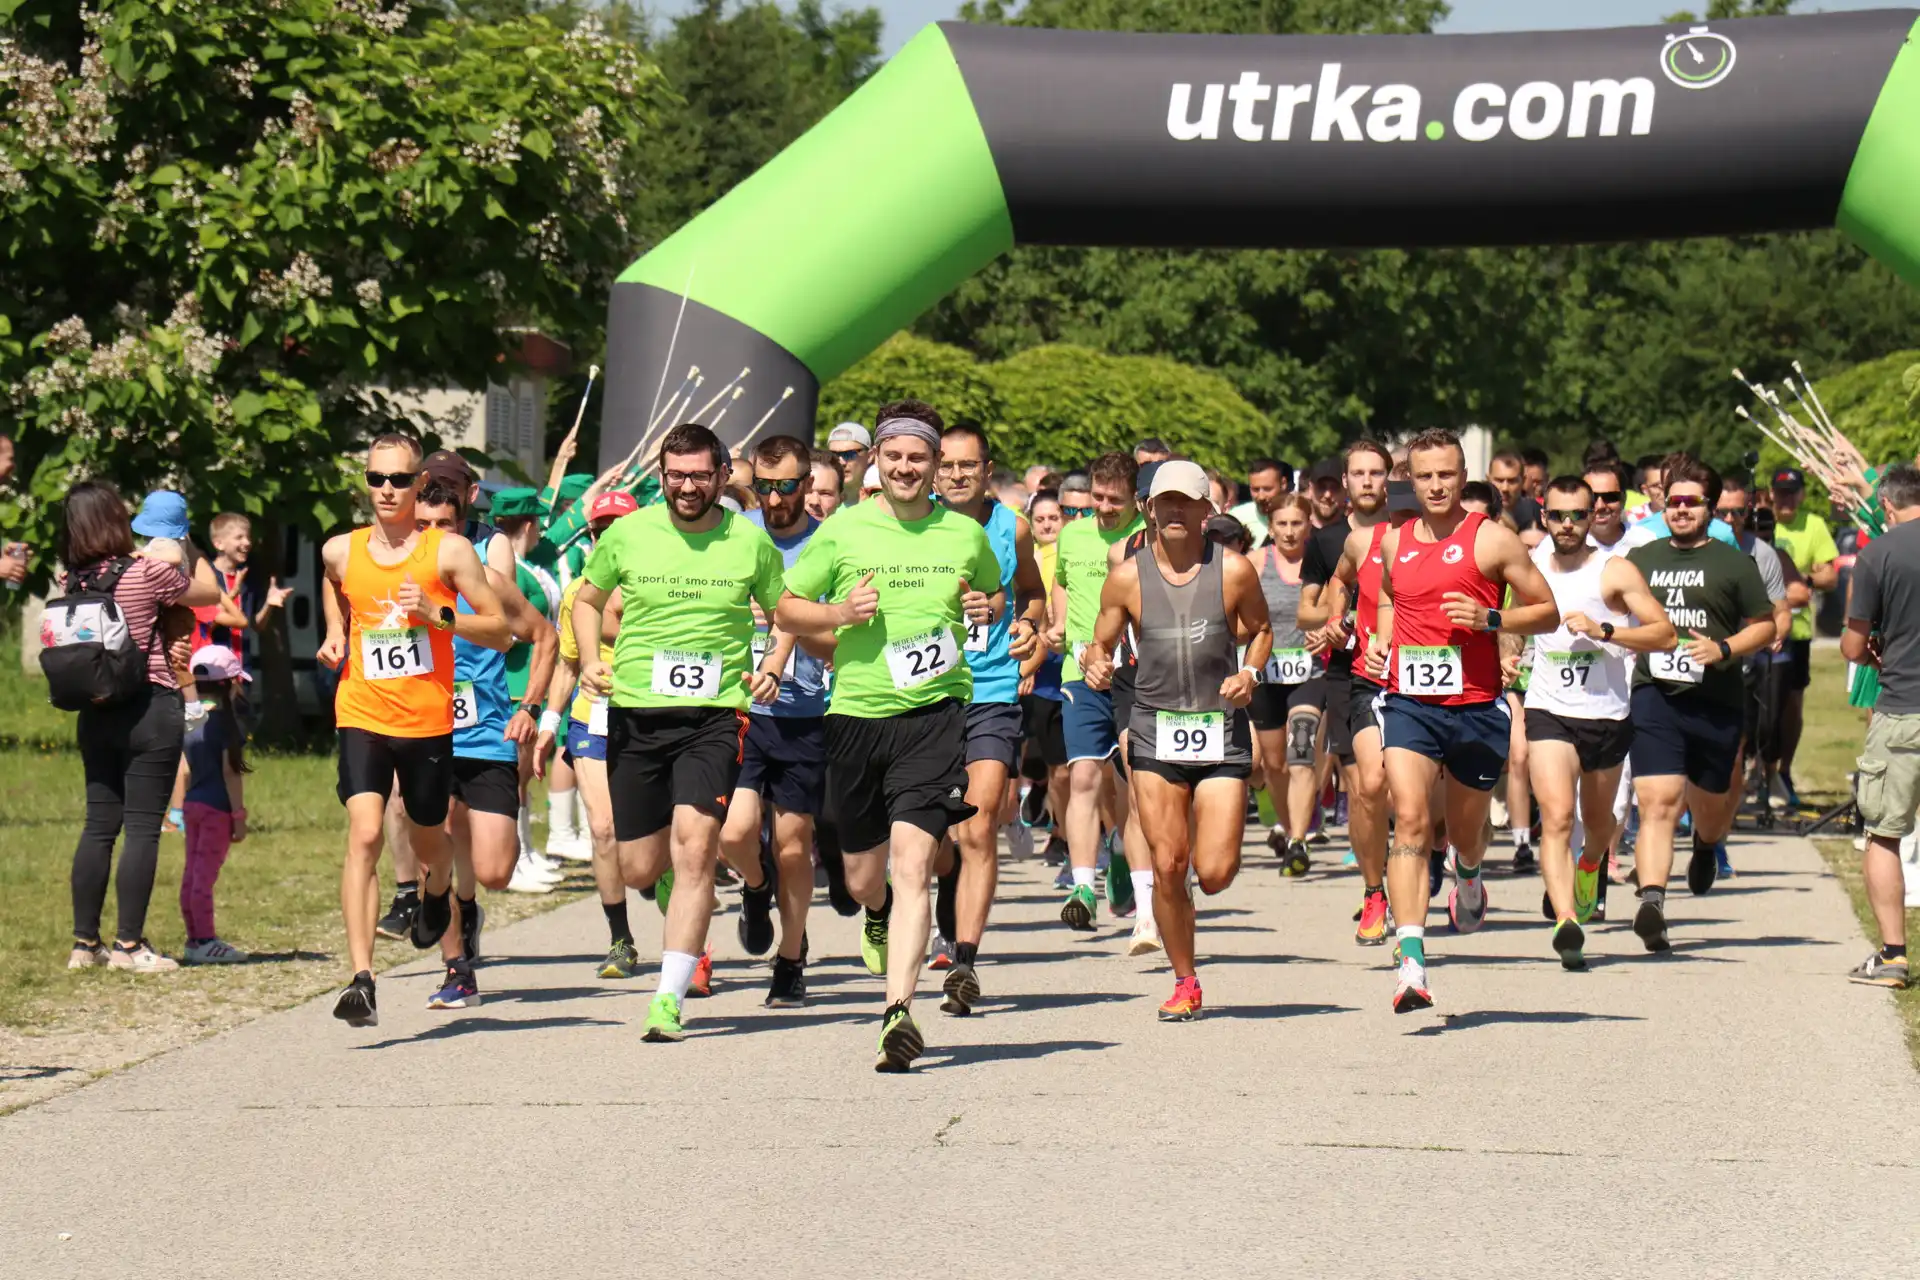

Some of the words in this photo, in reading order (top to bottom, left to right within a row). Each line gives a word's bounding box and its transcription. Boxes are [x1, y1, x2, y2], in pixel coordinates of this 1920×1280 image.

[1166, 63, 1656, 142] utrka.com
[905, 566, 929, 574] smo
[932, 565, 956, 574] zato
[685, 577, 708, 586] smo
[711, 578, 734, 587] zato
[888, 578, 925, 588] debeli
[1650, 570, 1705, 588] MAJICA
[667, 589, 702, 600] debeli
[1665, 588, 1686, 606] ZA
[892, 632, 929, 648] NEDELSKA
[371, 643, 421, 671] 161
[663, 649, 699, 659] NEDELSKA
[906, 643, 946, 677] 22
[1661, 652, 1691, 674] 36
[669, 664, 704, 690] 63
[1271, 660, 1306, 678] 106
[1405, 663, 1454, 687] 132
[1560, 666, 1590, 688] 97
[1173, 728, 1208, 752] 99
